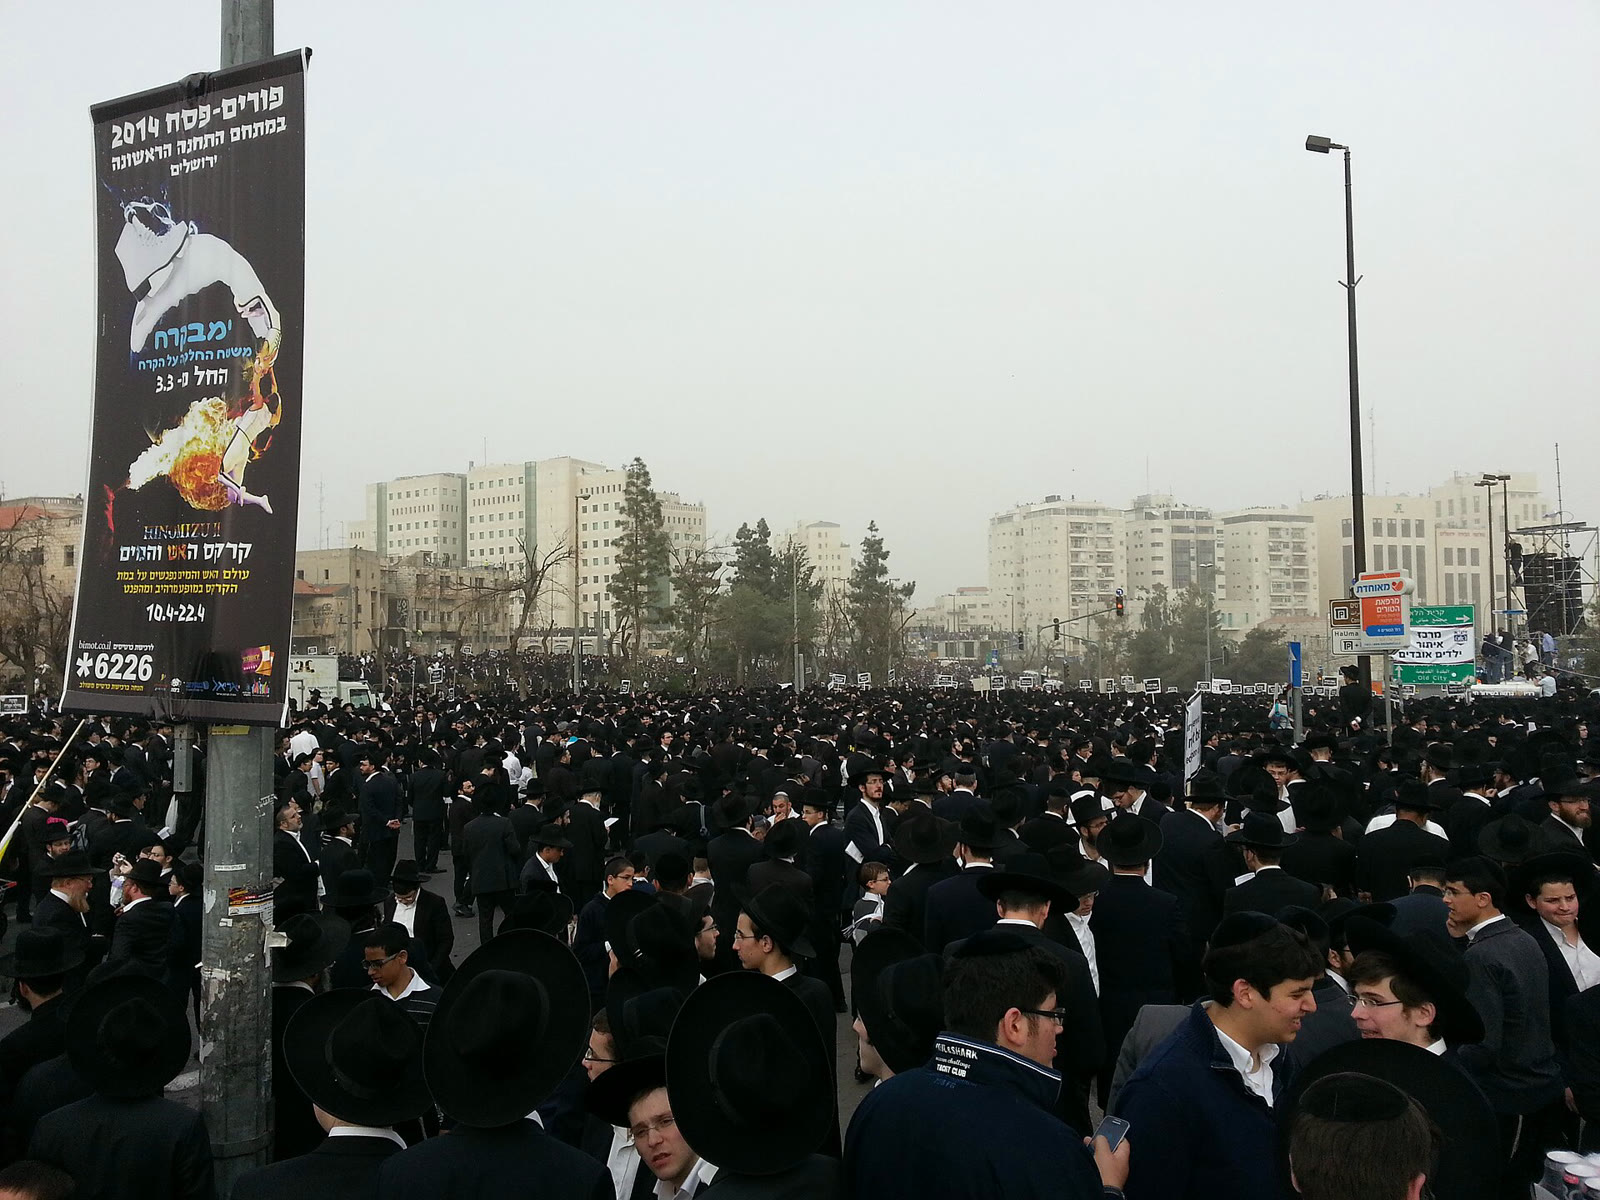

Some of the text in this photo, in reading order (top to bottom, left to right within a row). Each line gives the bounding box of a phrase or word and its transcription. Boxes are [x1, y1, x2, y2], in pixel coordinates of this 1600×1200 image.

[111, 86, 284, 148] פורים-פסח 2014
[112, 116, 287, 171] במתחם התחנה הראשונה
[170, 155, 218, 176] ירושלים
[138, 346, 252, 372] משטח החלקה על הקרח
[194, 365, 228, 386] החל
[156, 374, 174, 393] 3.3
[120, 542, 252, 564] קרקס האש והמים
[116, 570, 134, 581] במת
[137, 568, 148, 580] על
[202, 570, 219, 580] האש
[222, 568, 250, 580] עולם
[123, 583, 238, 596] הקרקס במופע מרהיב ומהפנט
[1356, 584, 1390, 593] מאוחדת
[1376, 598, 1400, 606] מרפאת
[146, 603, 206, 622] 10.4-22.4
[78, 640, 112, 650] bimot.co.il
[1436, 650, 1462, 658] ילדים
[952, 1067, 966, 1078] CLUB
